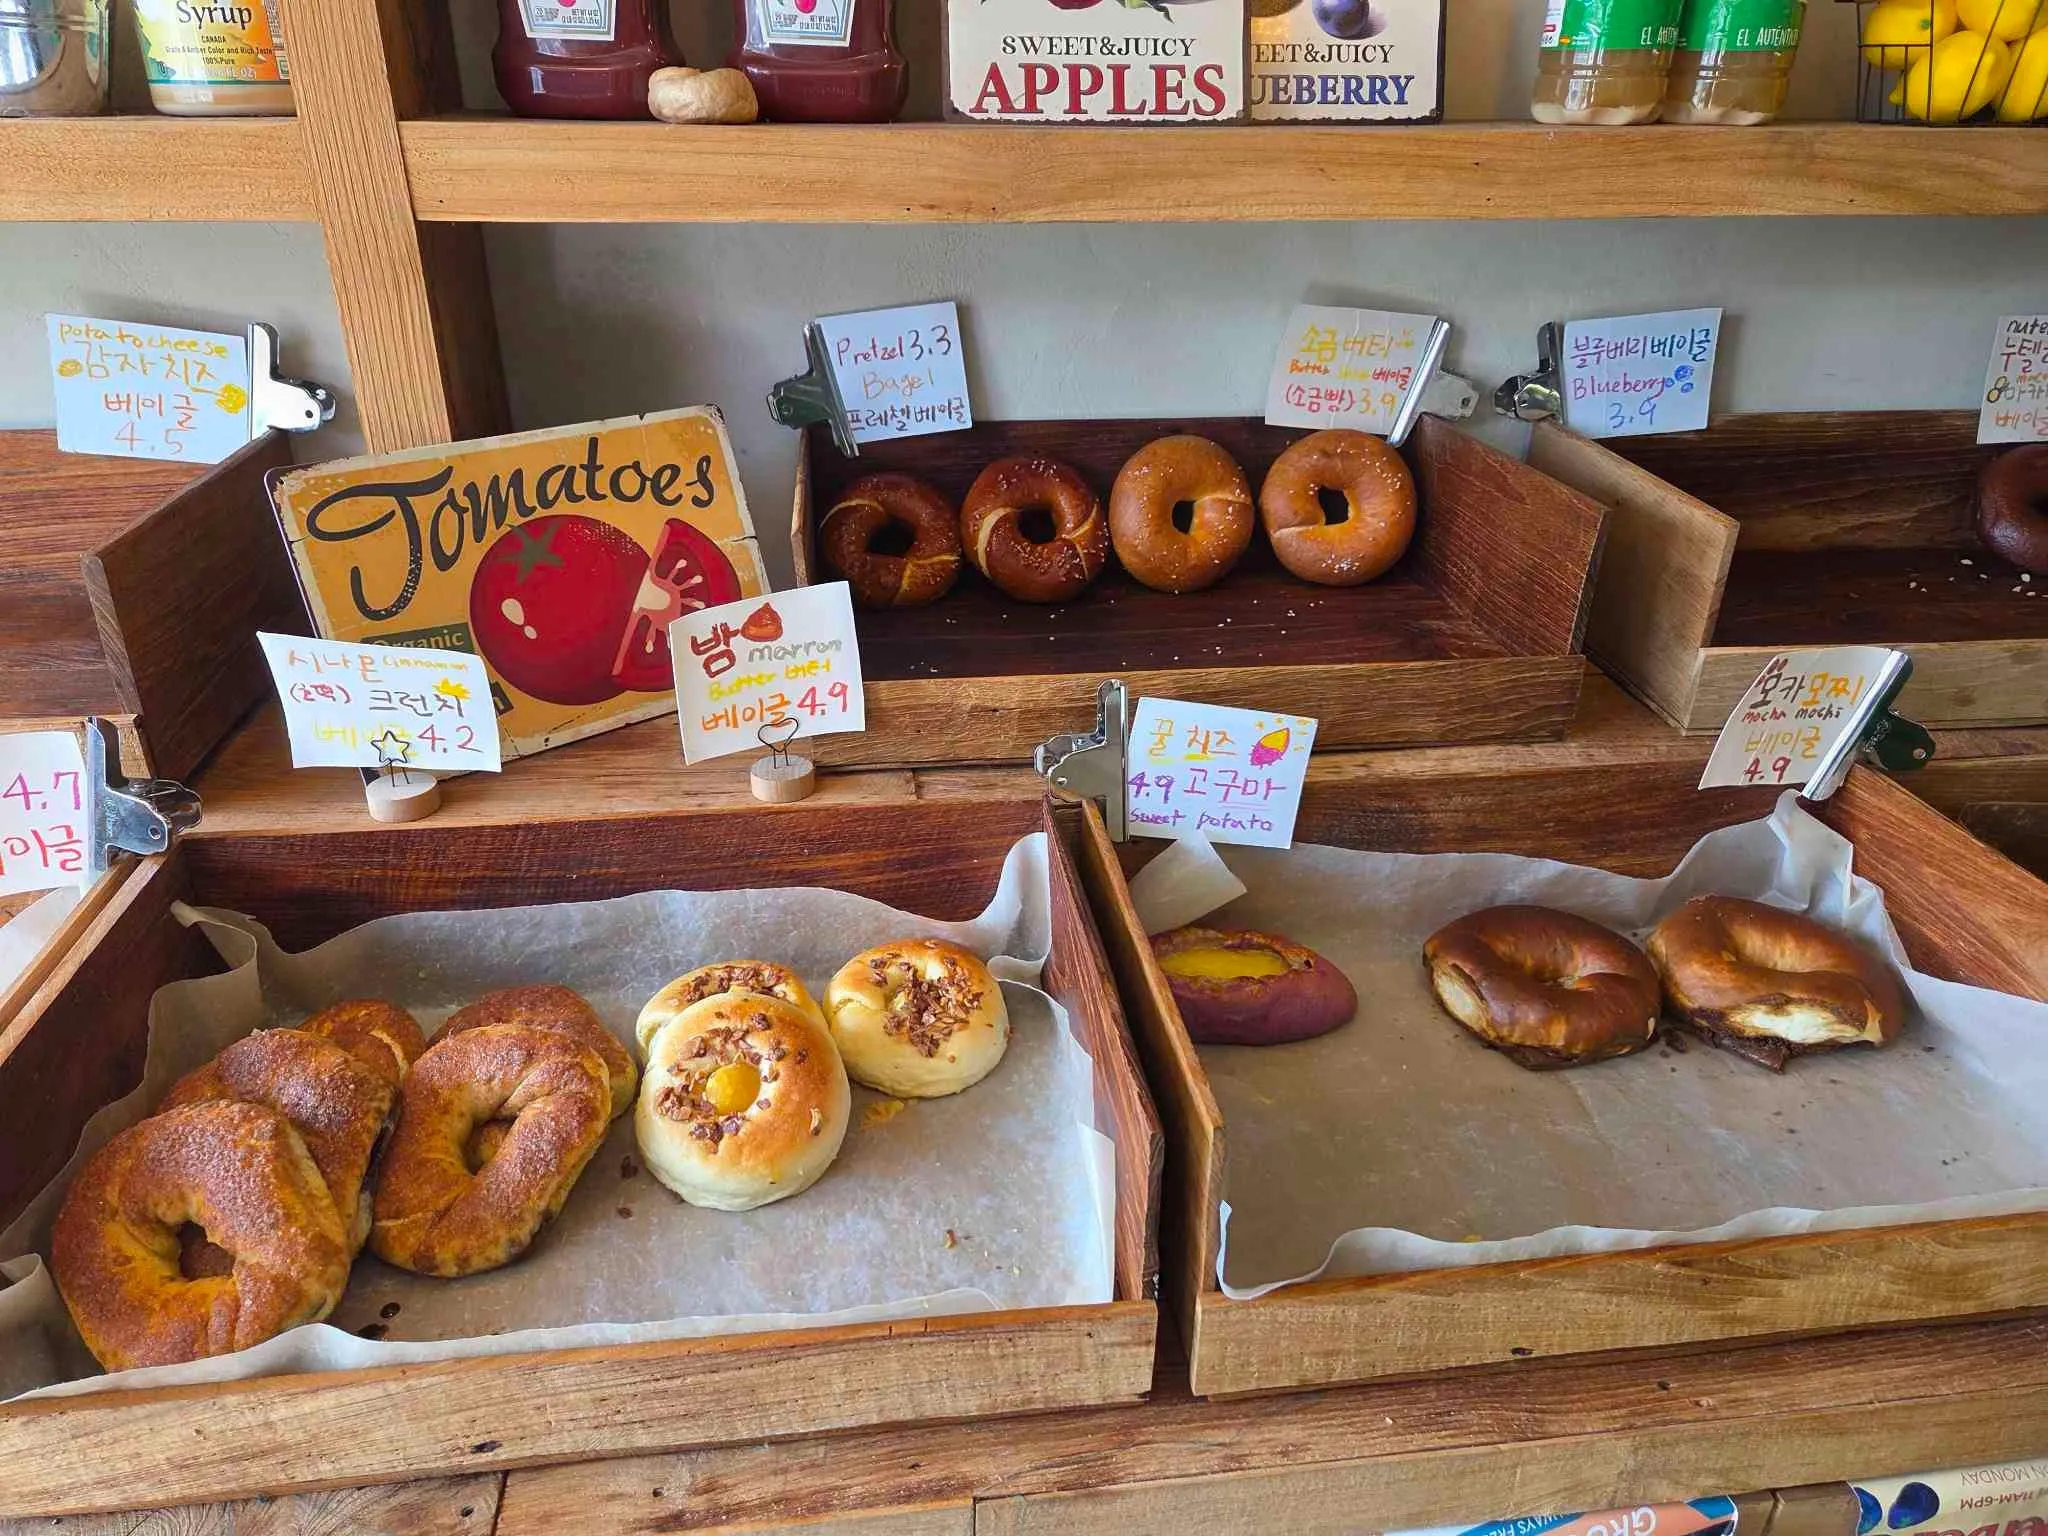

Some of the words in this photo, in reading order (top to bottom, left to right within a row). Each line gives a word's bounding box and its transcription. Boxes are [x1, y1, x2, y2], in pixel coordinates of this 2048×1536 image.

[176, 0, 252, 30] Syrup
[201, 35, 227, 43] CANADA
[1641, 26, 1652, 46] EL
[1736, 28, 1750, 47] EL
[1250, 43, 1394, 63] EET&JUICY
[969, 61, 1227, 116] APPLES
[2006, 317, 2048, 336] nute
[837, 335, 904, 366] Pretzel
[907, 324, 952, 361] 3.3
[863, 367, 935, 400] Bagel
[1372, 367, 1412, 391] 베이글
[1574, 372, 1666, 400] Blueberry
[104, 391, 201, 432] 베이글
[1359, 388, 1397, 416] 3.9
[1609, 397, 1657, 429] 3.9
[114, 420, 184, 454] 4.5
[307, 437, 715, 621] Tomatoes
[689, 621, 740, 679] 밤
[748, 638, 842, 663] marron
[288, 650, 383, 683] 시나몬
[702, 692, 792, 731] 베이글
[796, 681, 849, 716] 4.9
[1742, 707, 1787, 723] mocha
[1794, 704, 1843, 720] mochi
[418, 723, 484, 753] 4.2
[1744, 726, 1822, 759] 베이글
[1744, 756, 1792, 783] 4.9
[2, 772, 81, 811] 4.7
[1127, 771, 1176, 804] 4.9
[1183, 768, 1287, 801] 고구마
[1196, 809, 1273, 831] potato
[0, 825, 83, 876] 이글
[1960, 1466, 2028, 1487] MONDAY
